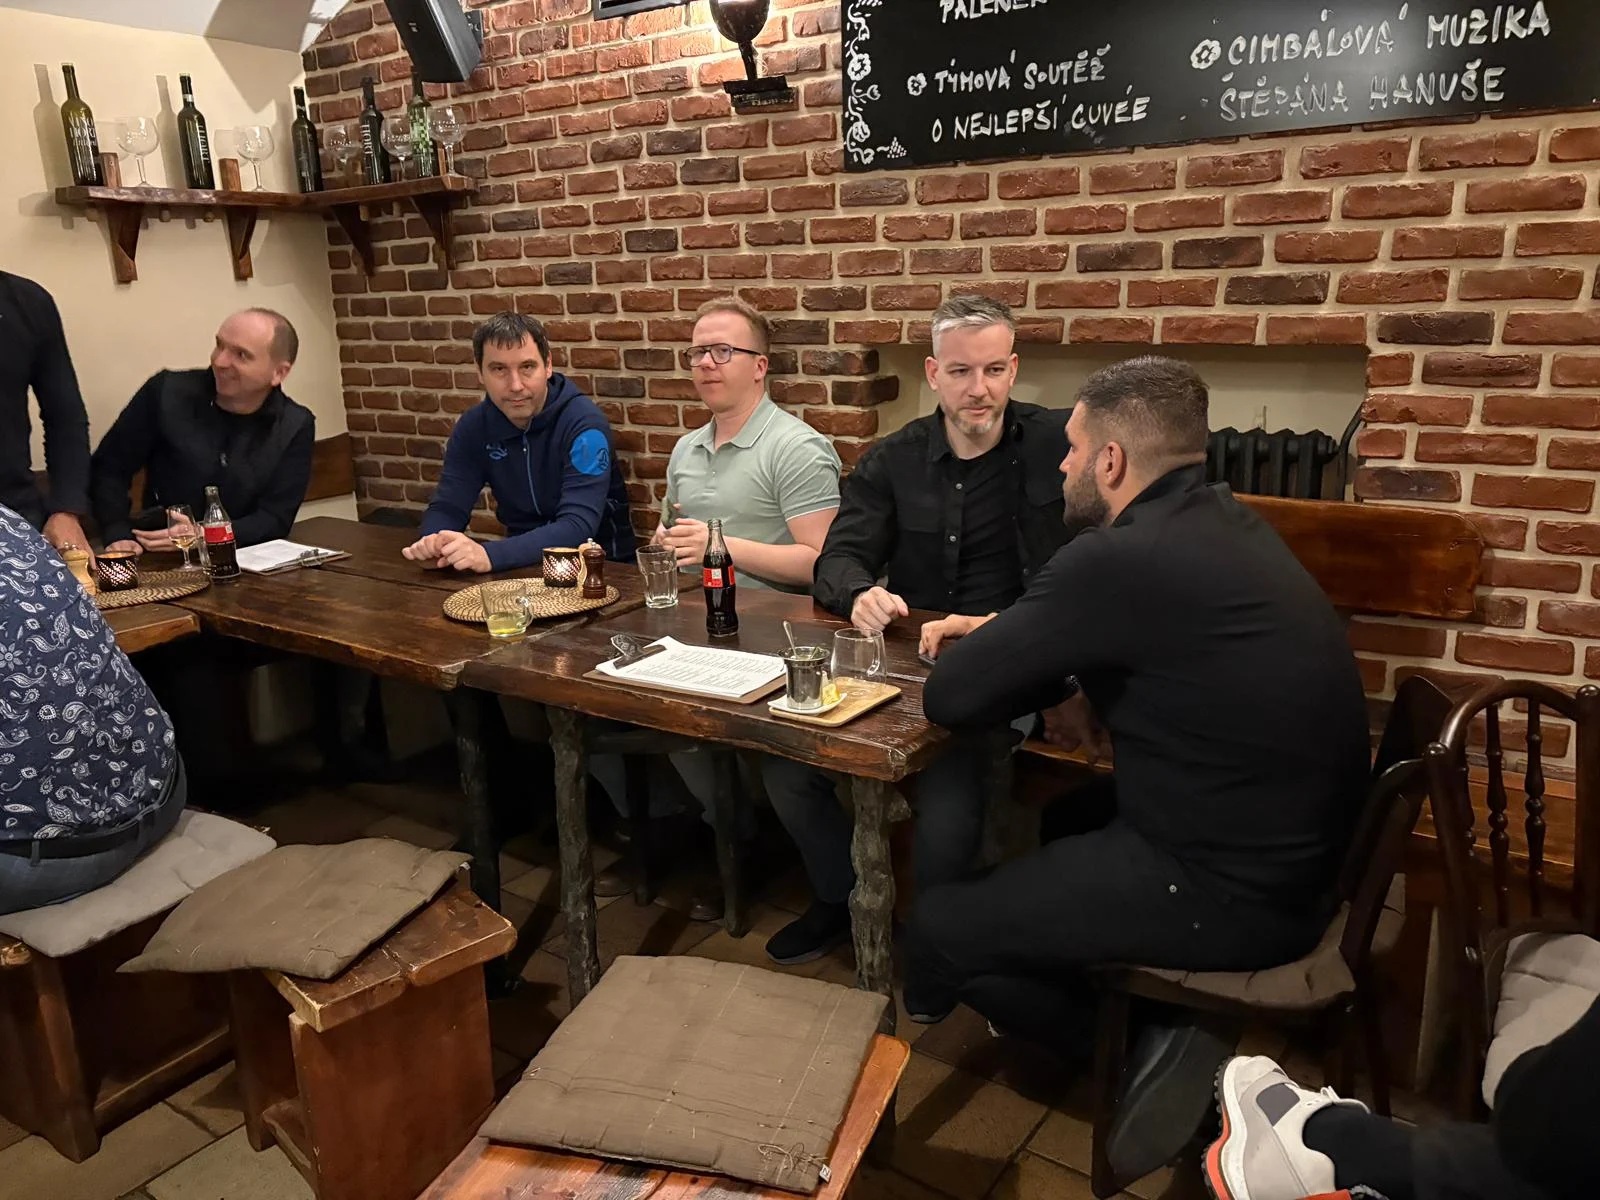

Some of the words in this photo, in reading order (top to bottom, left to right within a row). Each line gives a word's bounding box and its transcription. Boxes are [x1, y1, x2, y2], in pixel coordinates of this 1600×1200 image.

[1426, 1, 1550, 49] MUZIKA
[934, 50, 1016, 94] TÝMOVÁ
[1024, 44, 1111, 90] SOUTĚŽ
[1369, 59, 1506, 110] HANUŠE
[932, 119, 942, 143] O
[954, 94, 1067, 140] NEJLEPŠÍ
[1071, 85, 1151, 129] CUVÉE
